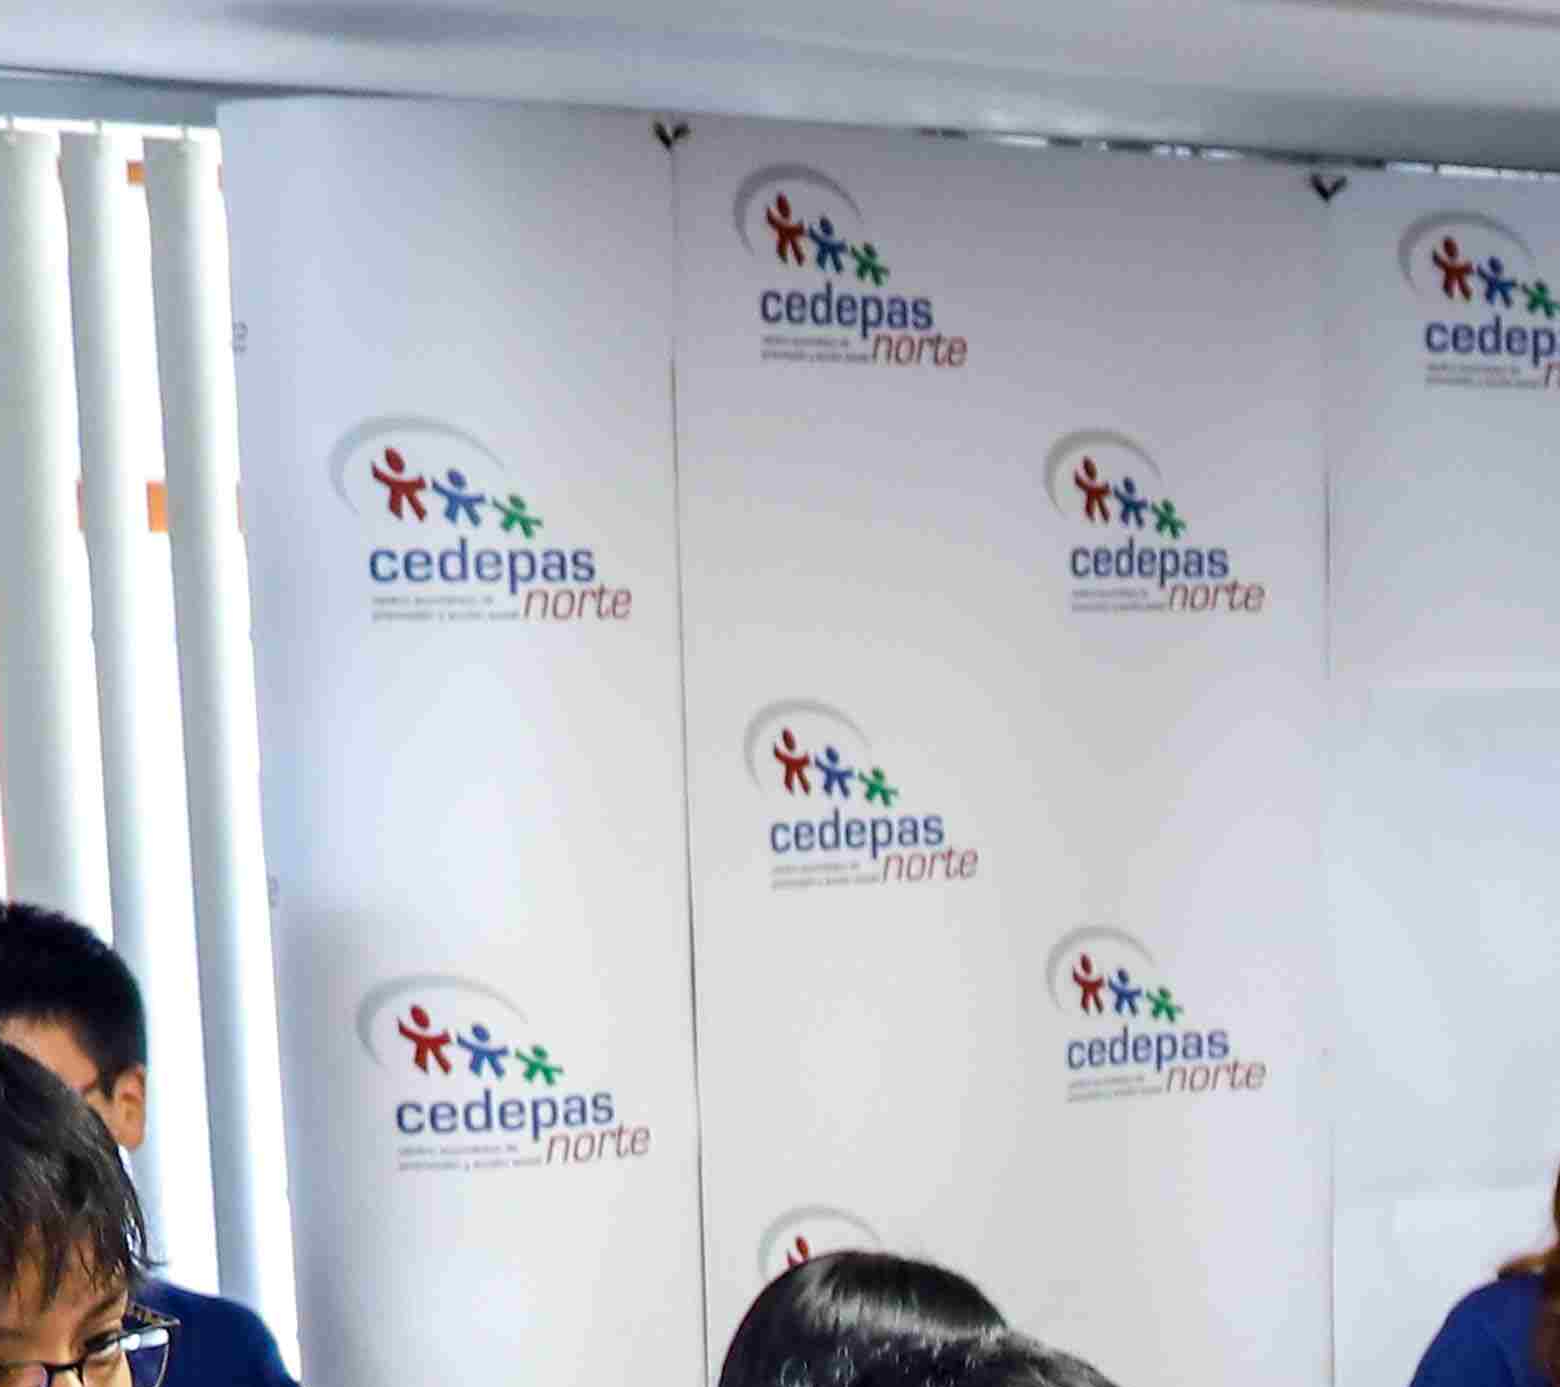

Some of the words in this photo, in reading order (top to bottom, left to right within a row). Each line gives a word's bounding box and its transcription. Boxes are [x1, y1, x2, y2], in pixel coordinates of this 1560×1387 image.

[760, 284, 933, 339] cedepas
[871, 328, 967, 369] norte
[368, 539, 596, 595] cedepas
[1070, 539, 1228, 591] cedepas
[523, 584, 631, 622] norte
[1168, 578, 1264, 615] norte
[770, 809, 944, 859] cedepas
[882, 844, 978, 884] norte
[1066, 1026, 1229, 1071] cedepas
[1165, 1057, 1265, 1095] norte
[395, 1089, 615, 1142] cedepas
[544, 1123, 650, 1164] norte
